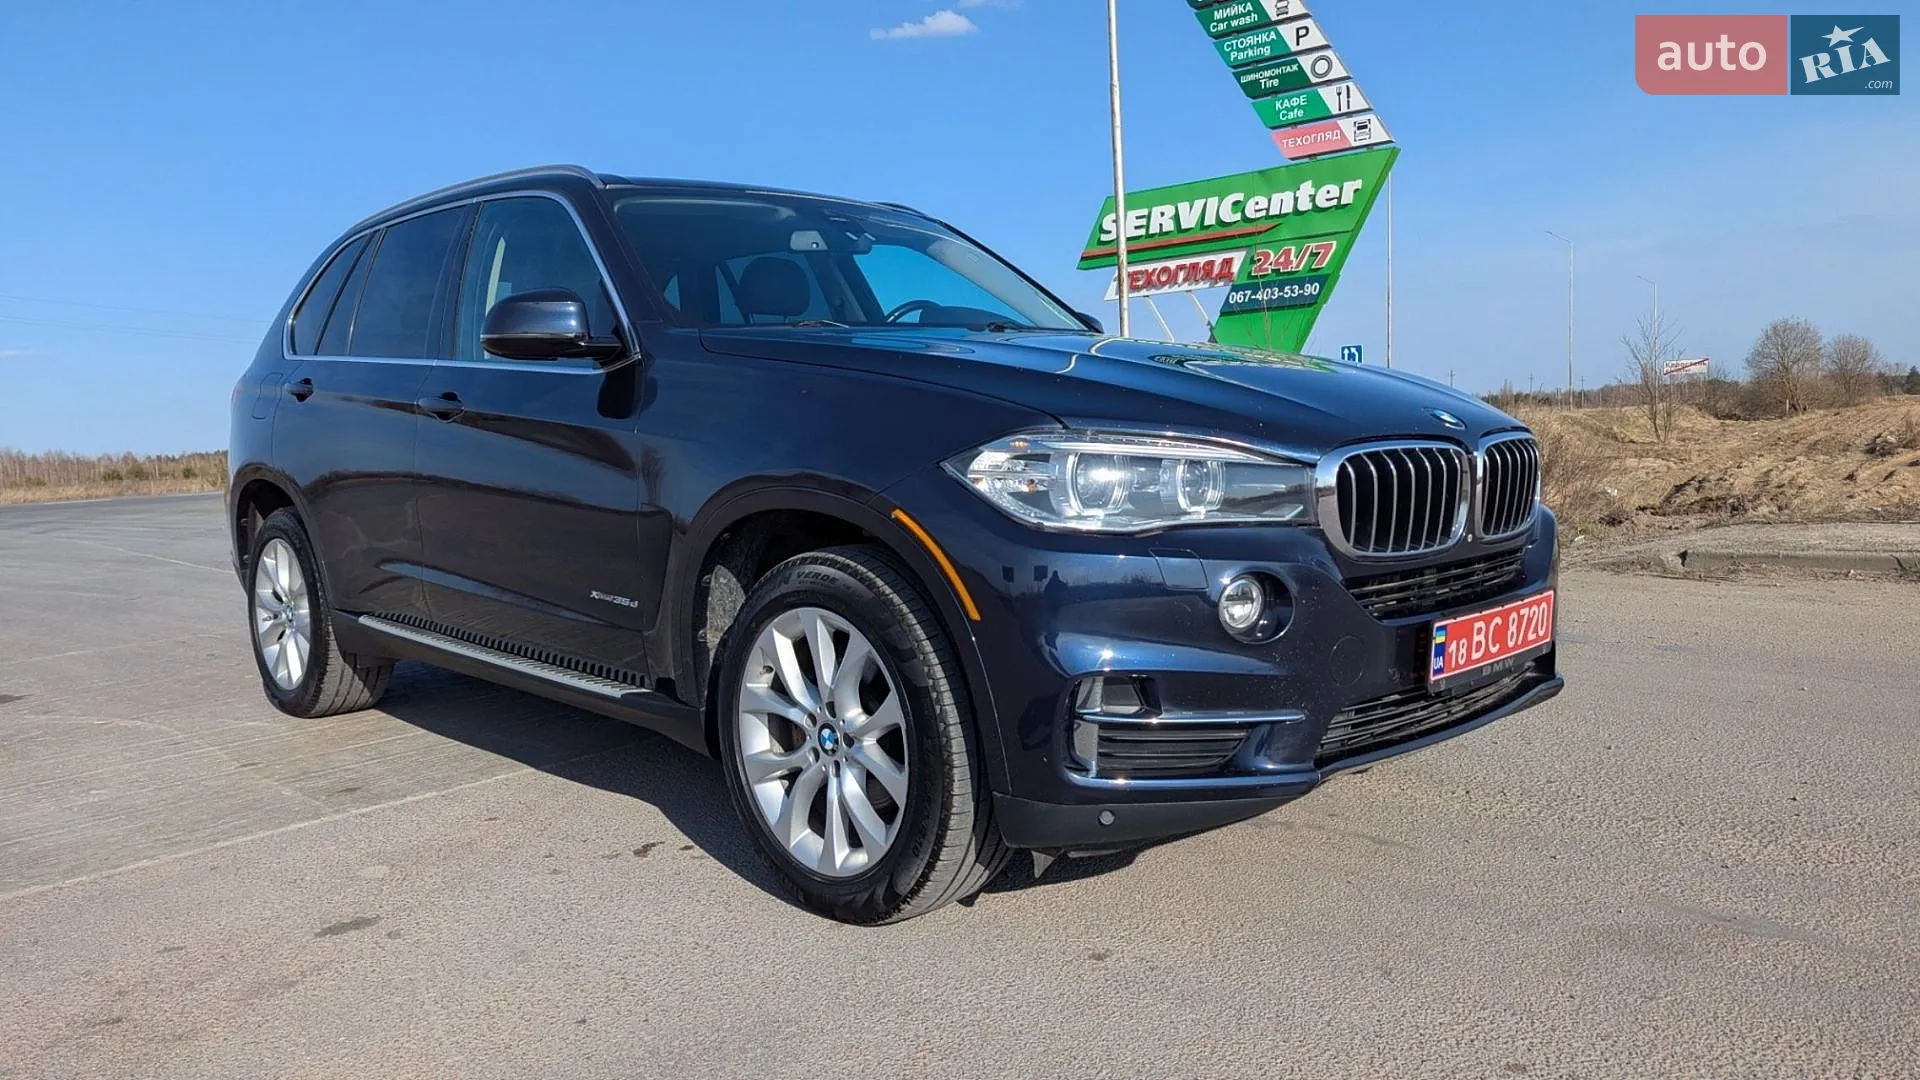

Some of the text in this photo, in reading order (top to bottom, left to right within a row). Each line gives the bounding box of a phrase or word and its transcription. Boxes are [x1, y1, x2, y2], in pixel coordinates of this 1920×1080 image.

[1214, 2, 1253, 20] МИЙКА
[1209, 12, 1258, 32] Car wash
[1224, 31, 1276, 51] СТОЯНКА
[1295, 25, 1310, 46] P
[1230, 44, 1271, 62] Parking
[1241, 64, 1298, 82] ШИНОМОНТАЖ
[1259, 77, 1279, 89] Tire
[1275, 95, 1307, 111] КАФЕ
[1279, 108, 1304, 121] Cafe
[1282, 129, 1341, 149] ТЕХОГЛЯД
[1100, 179, 1362, 241] SERVICenter
[1251, 241, 1337, 276] 24/7
[1126, 256, 1235, 290] ЕХОГЛЯД
[1228, 282, 1320, 304] 067-403-53-90
[1448, 602, 1548, 668] 18 BC 8720
[1433, 656, 1444, 669] UA
